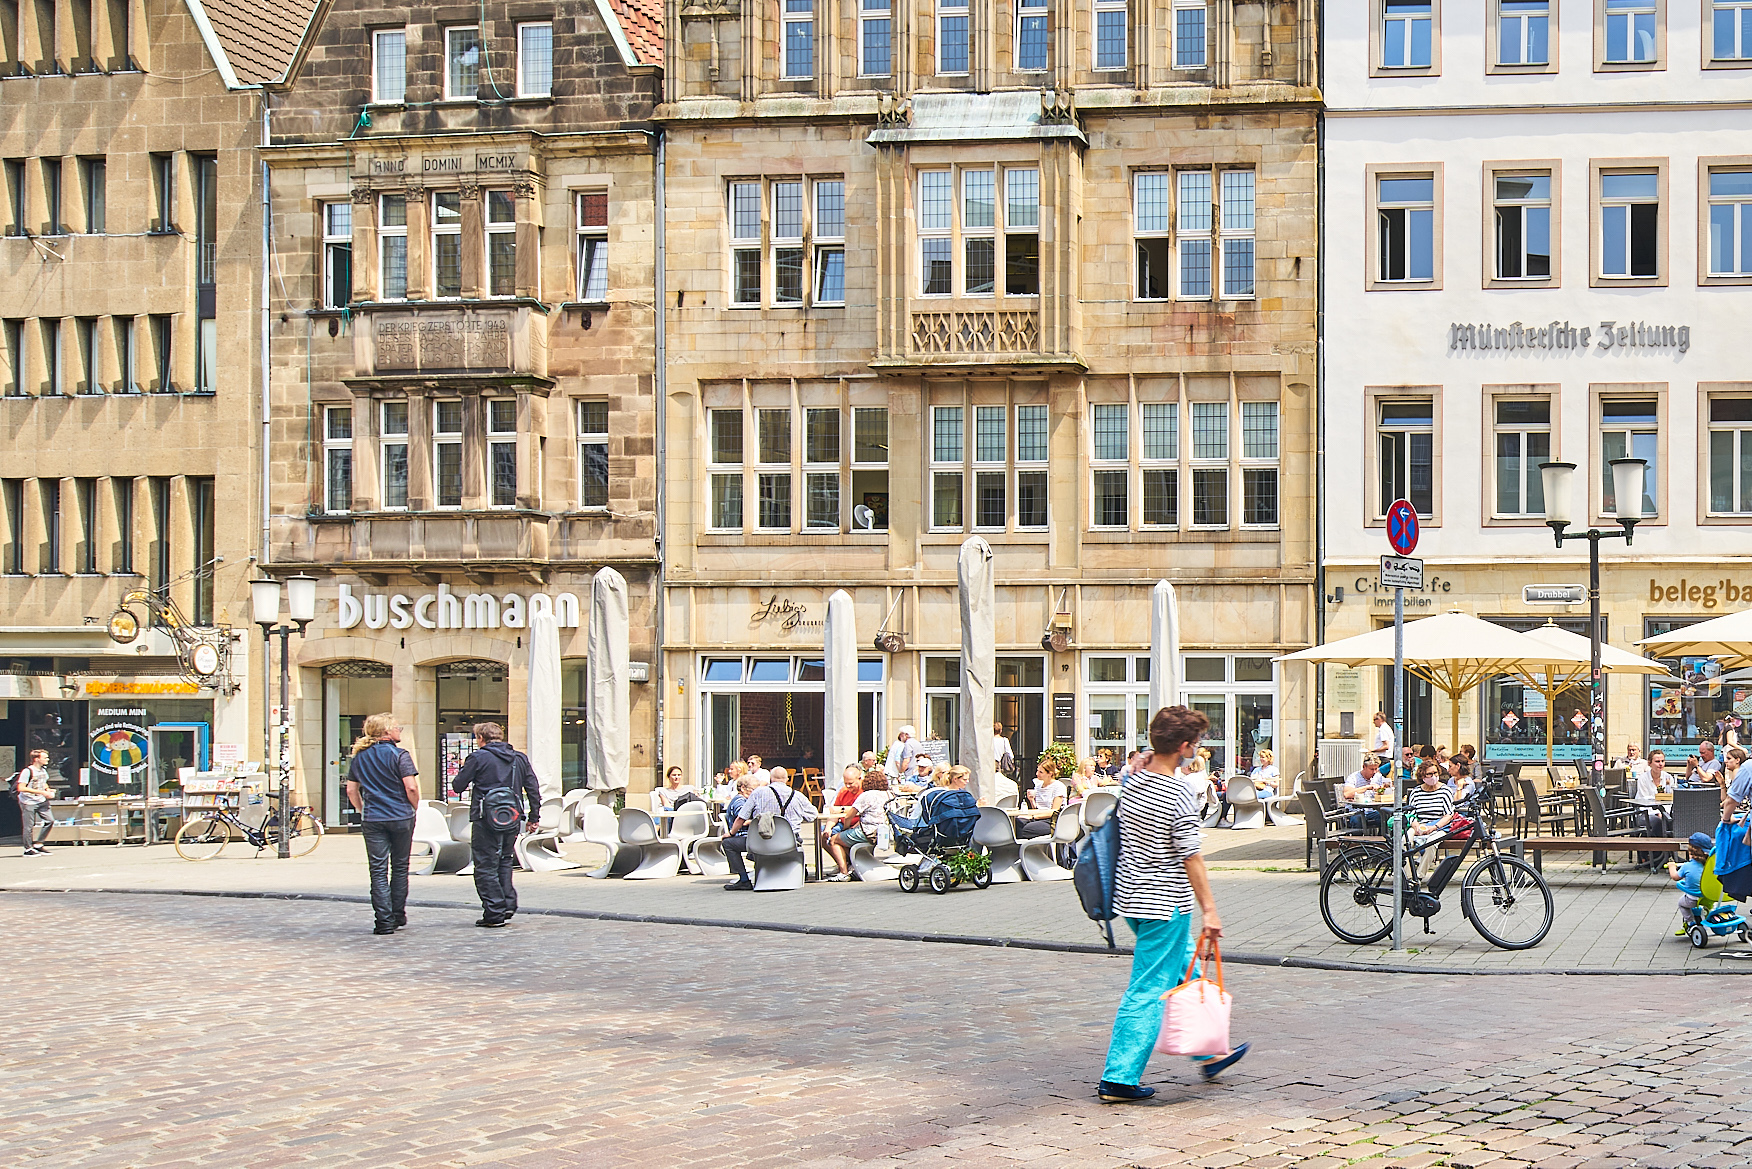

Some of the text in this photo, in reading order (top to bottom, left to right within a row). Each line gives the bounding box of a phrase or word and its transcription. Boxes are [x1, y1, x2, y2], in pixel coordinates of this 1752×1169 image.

[374, 155, 516, 173] ANNO DOMINI MCMIX
[379, 322, 396, 333] DER
[398, 321, 426, 332] KRIEG
[485, 320, 506, 330] 1943
[474, 331, 506, 341] JAHRE
[1451, 320, 1691, 354] Münstersche Zeitung
[1537, 589, 1571, 599] Drubbel
[339, 583, 580, 629] buschmann
[1374, 596, 1432, 607] Immbilien
[1061, 664, 1069, 672] 19
[97, 708, 147, 716] MEDIUM MINI
